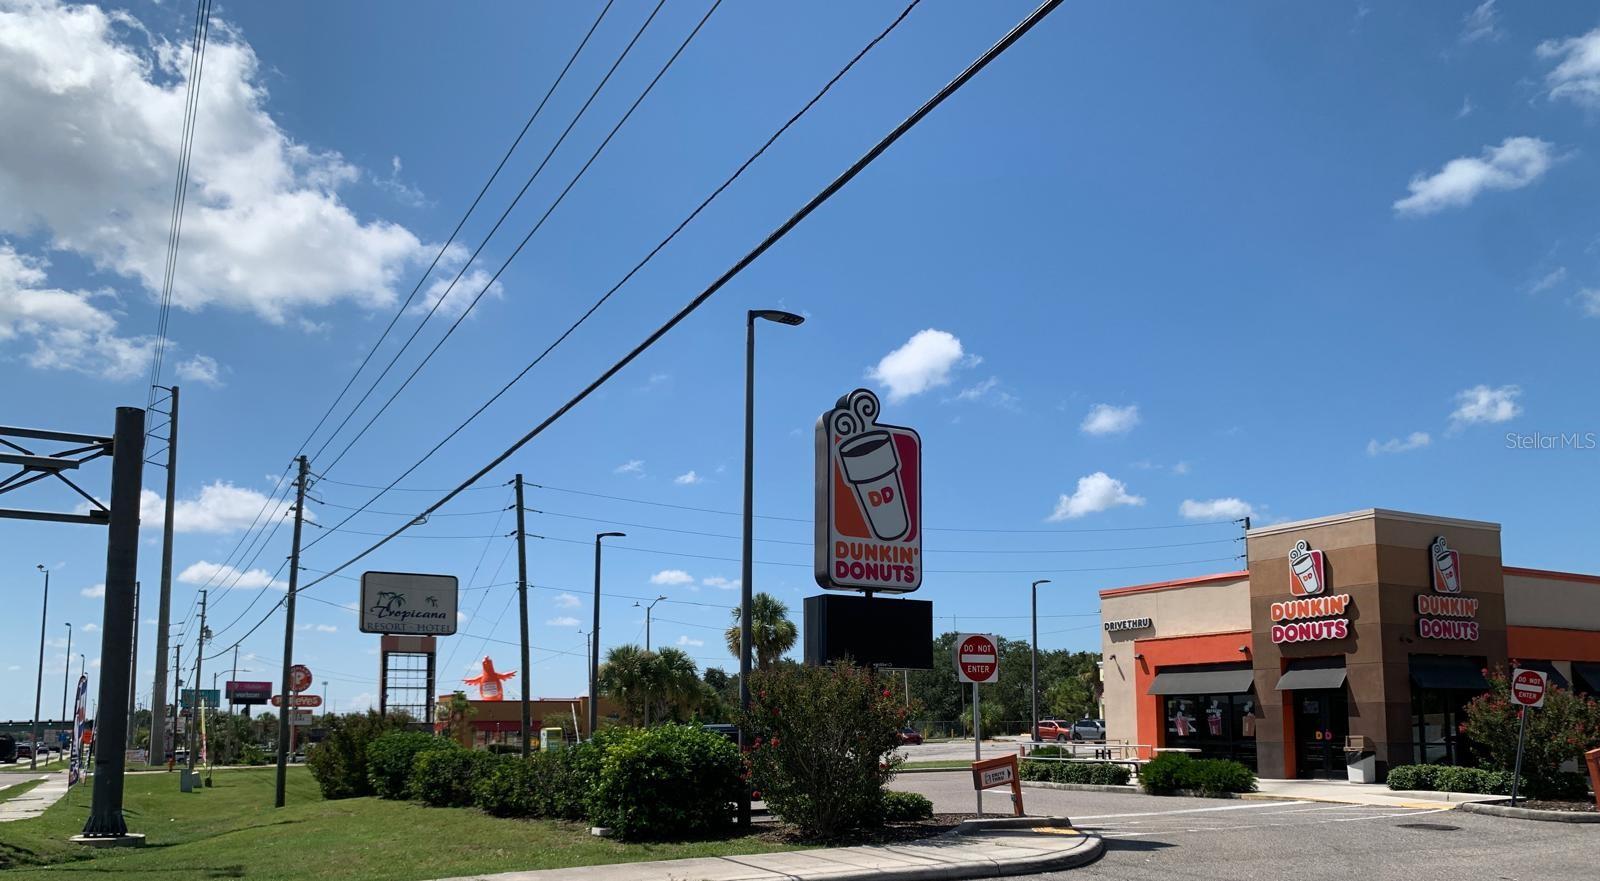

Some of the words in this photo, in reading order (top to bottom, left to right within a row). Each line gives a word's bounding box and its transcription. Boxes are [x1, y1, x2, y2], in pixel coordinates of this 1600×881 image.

[868, 486, 895, 507] DD
[835, 541, 919, 564] DUNKIN'
[835, 562, 916, 583] DONUTS
[370, 605, 447, 621] Tropicana
[1271, 594, 1350, 621] DUNKIN'
[1418, 595, 1478, 617] DUNKIN'
[367, 622, 408, 631] RESORT
[417, 623, 451, 632] HOTEL
[1272, 619, 1349, 643] DONUTS
[1420, 618, 1479, 641] DONUTS
[964, 645, 974, 653] DO
[978, 645, 991, 653] NOT
[967, 665, 990, 673] ENTER
[1518, 691, 1537, 699] ENTER
